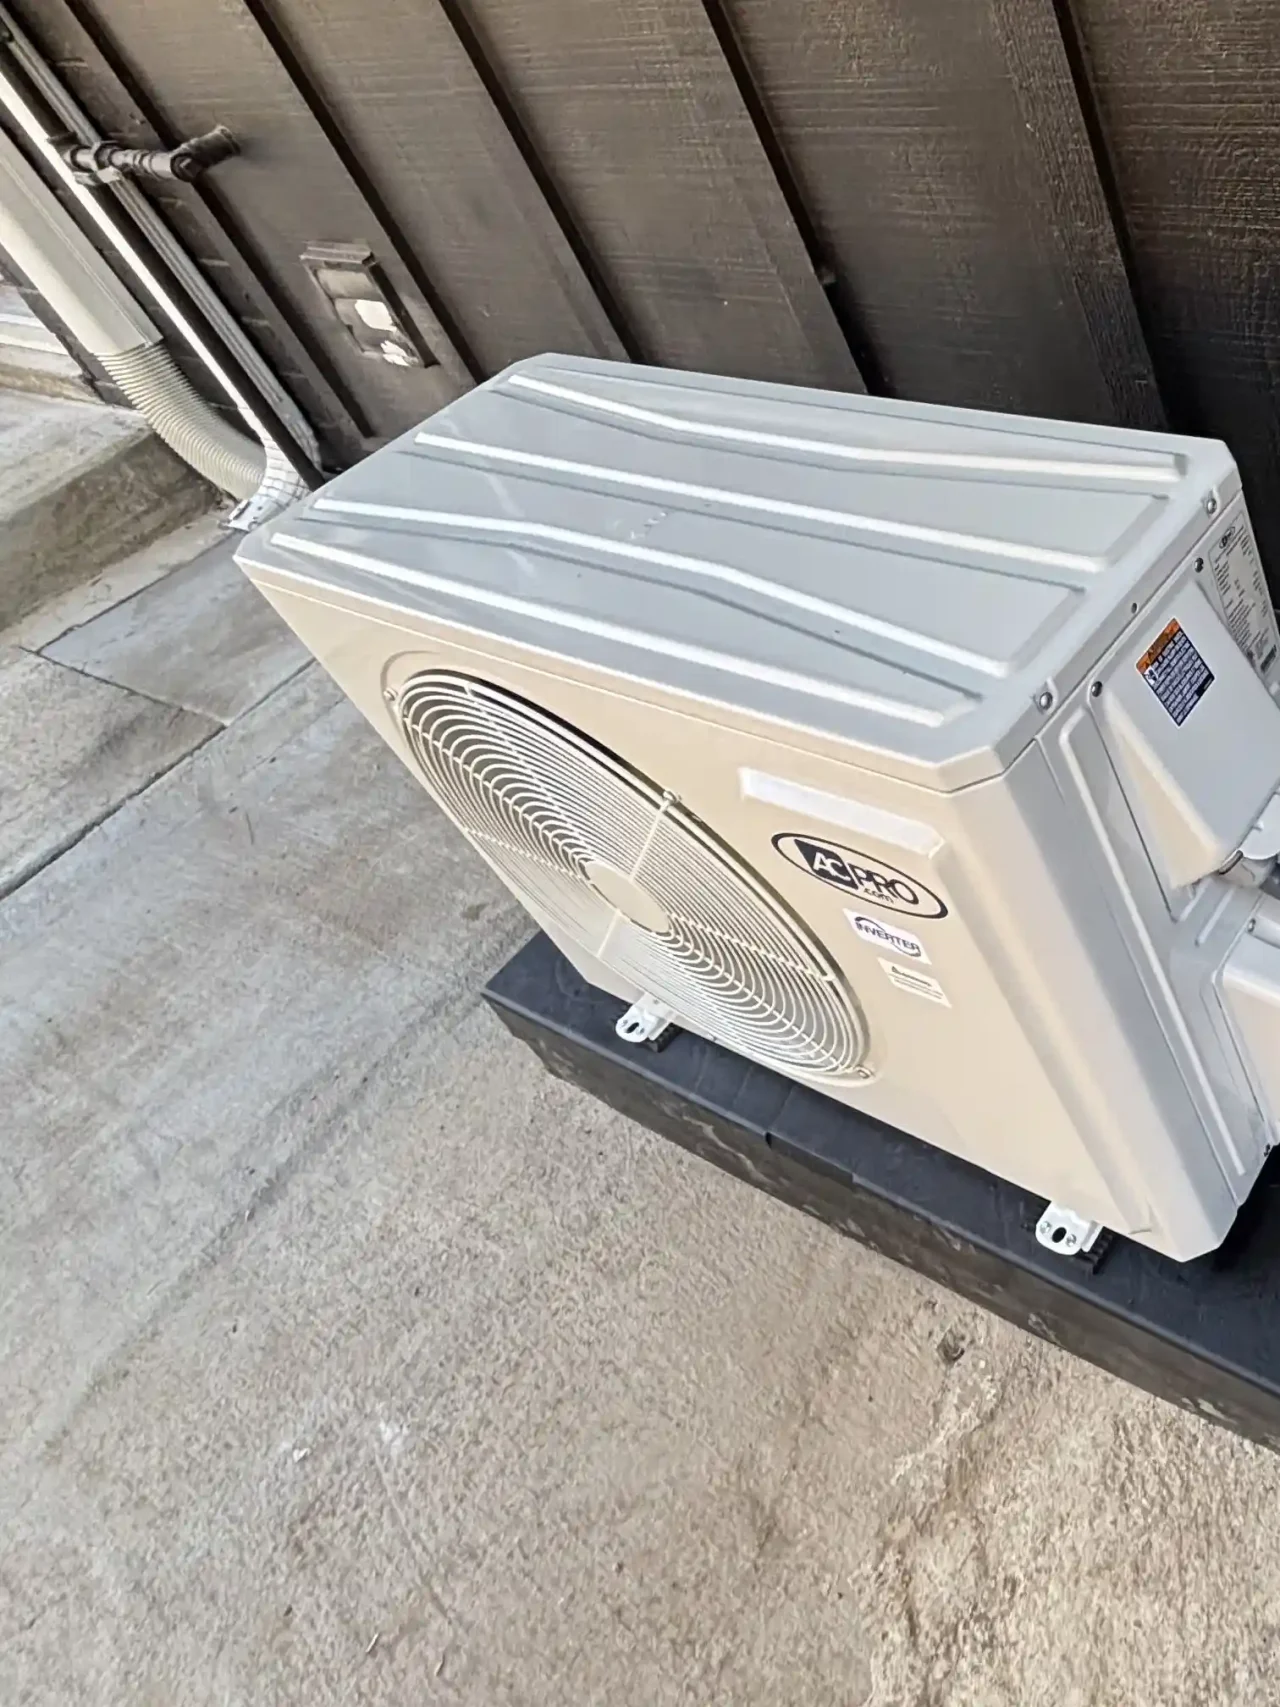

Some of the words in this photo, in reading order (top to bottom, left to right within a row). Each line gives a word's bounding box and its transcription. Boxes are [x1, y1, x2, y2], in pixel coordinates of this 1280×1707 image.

[813, 852, 851, 881] AC
[848, 863, 919, 905] PRO
[856, 922, 920, 951] INVERTER
